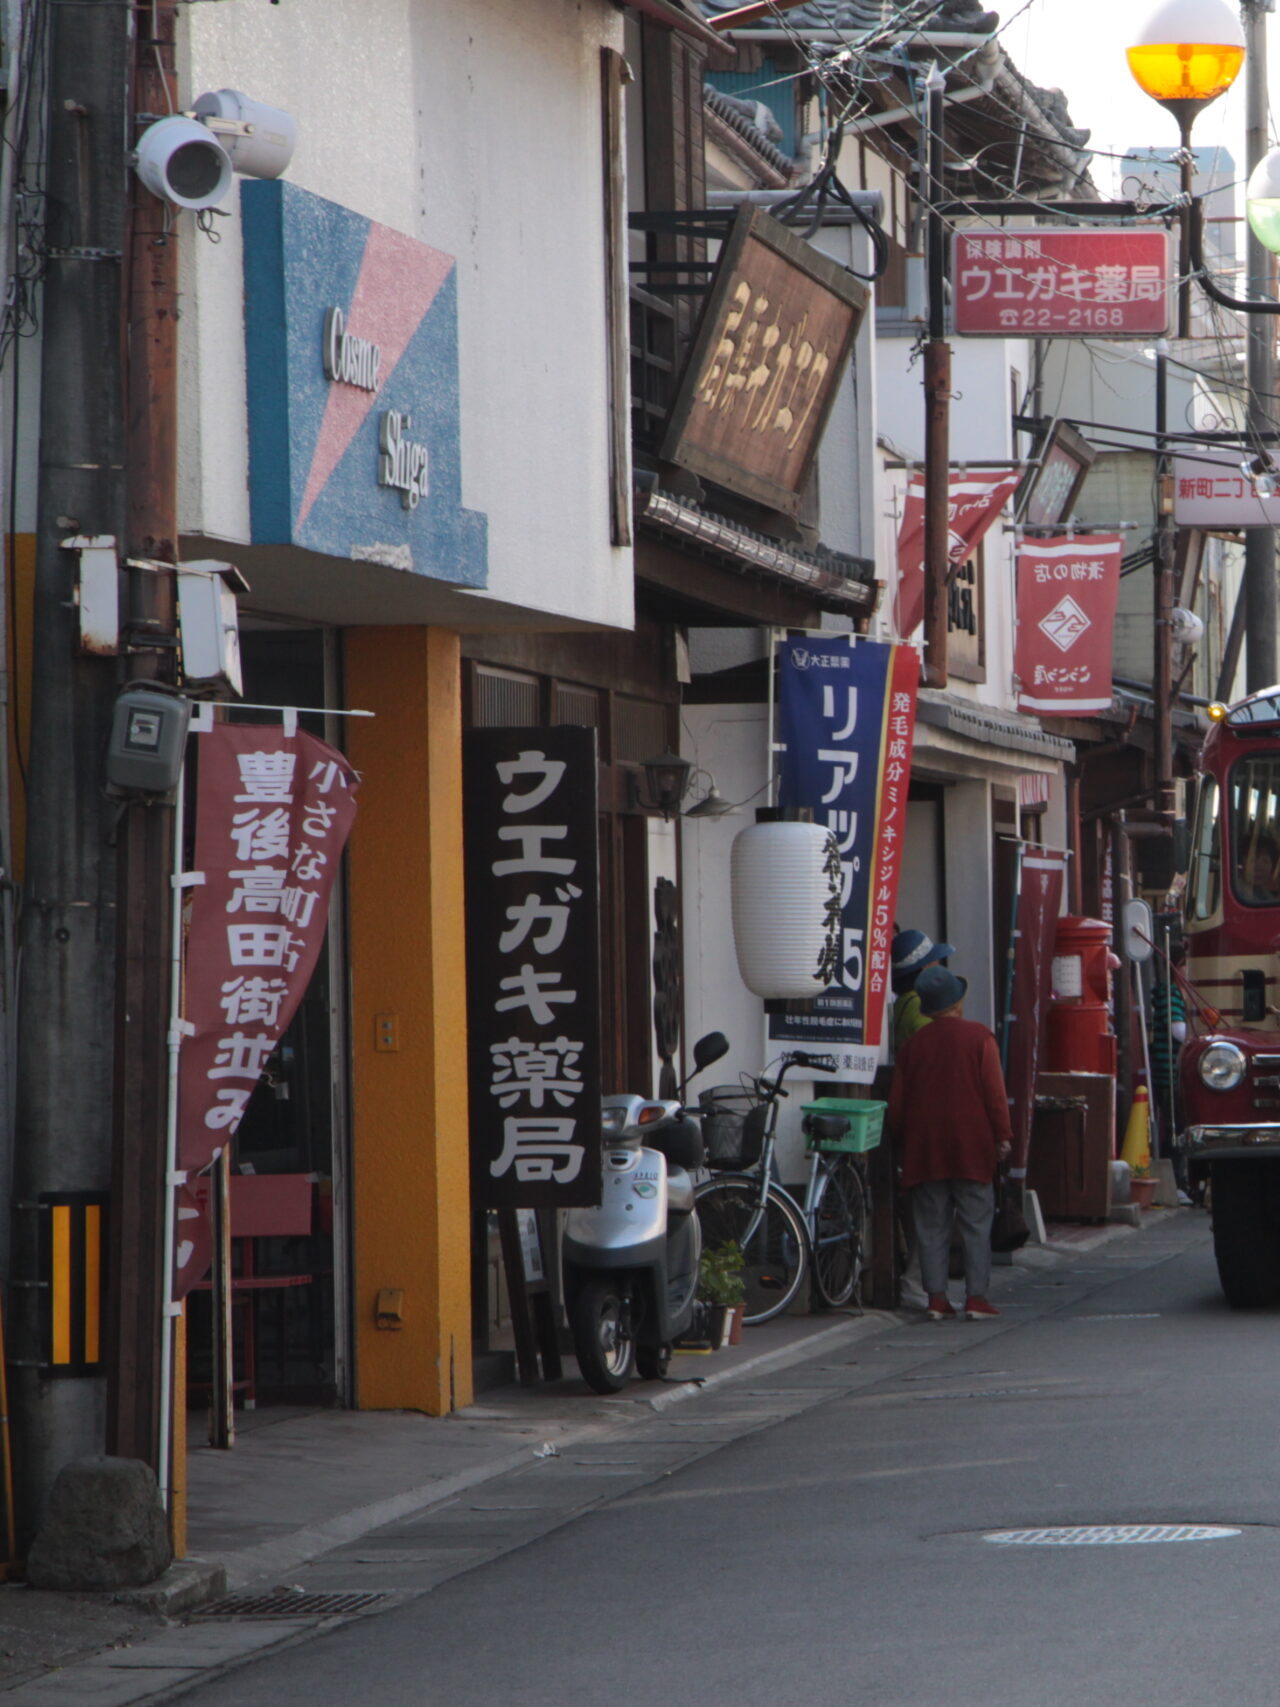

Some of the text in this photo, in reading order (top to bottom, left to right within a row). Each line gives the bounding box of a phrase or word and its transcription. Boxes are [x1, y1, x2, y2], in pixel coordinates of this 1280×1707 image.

[962, 264, 1161, 302] ウエガキ薬局
[966, 239, 1041, 259] 保険調剤
[325, 306, 381, 393] Cosme
[1022, 308, 1124, 326] 22-2168
[382, 409, 429, 510] Shiga
[870, 692, 911, 993] 発毛成分ミノキシジル5%配合
[489, 750, 585, 1184] ウエガキ薬局
